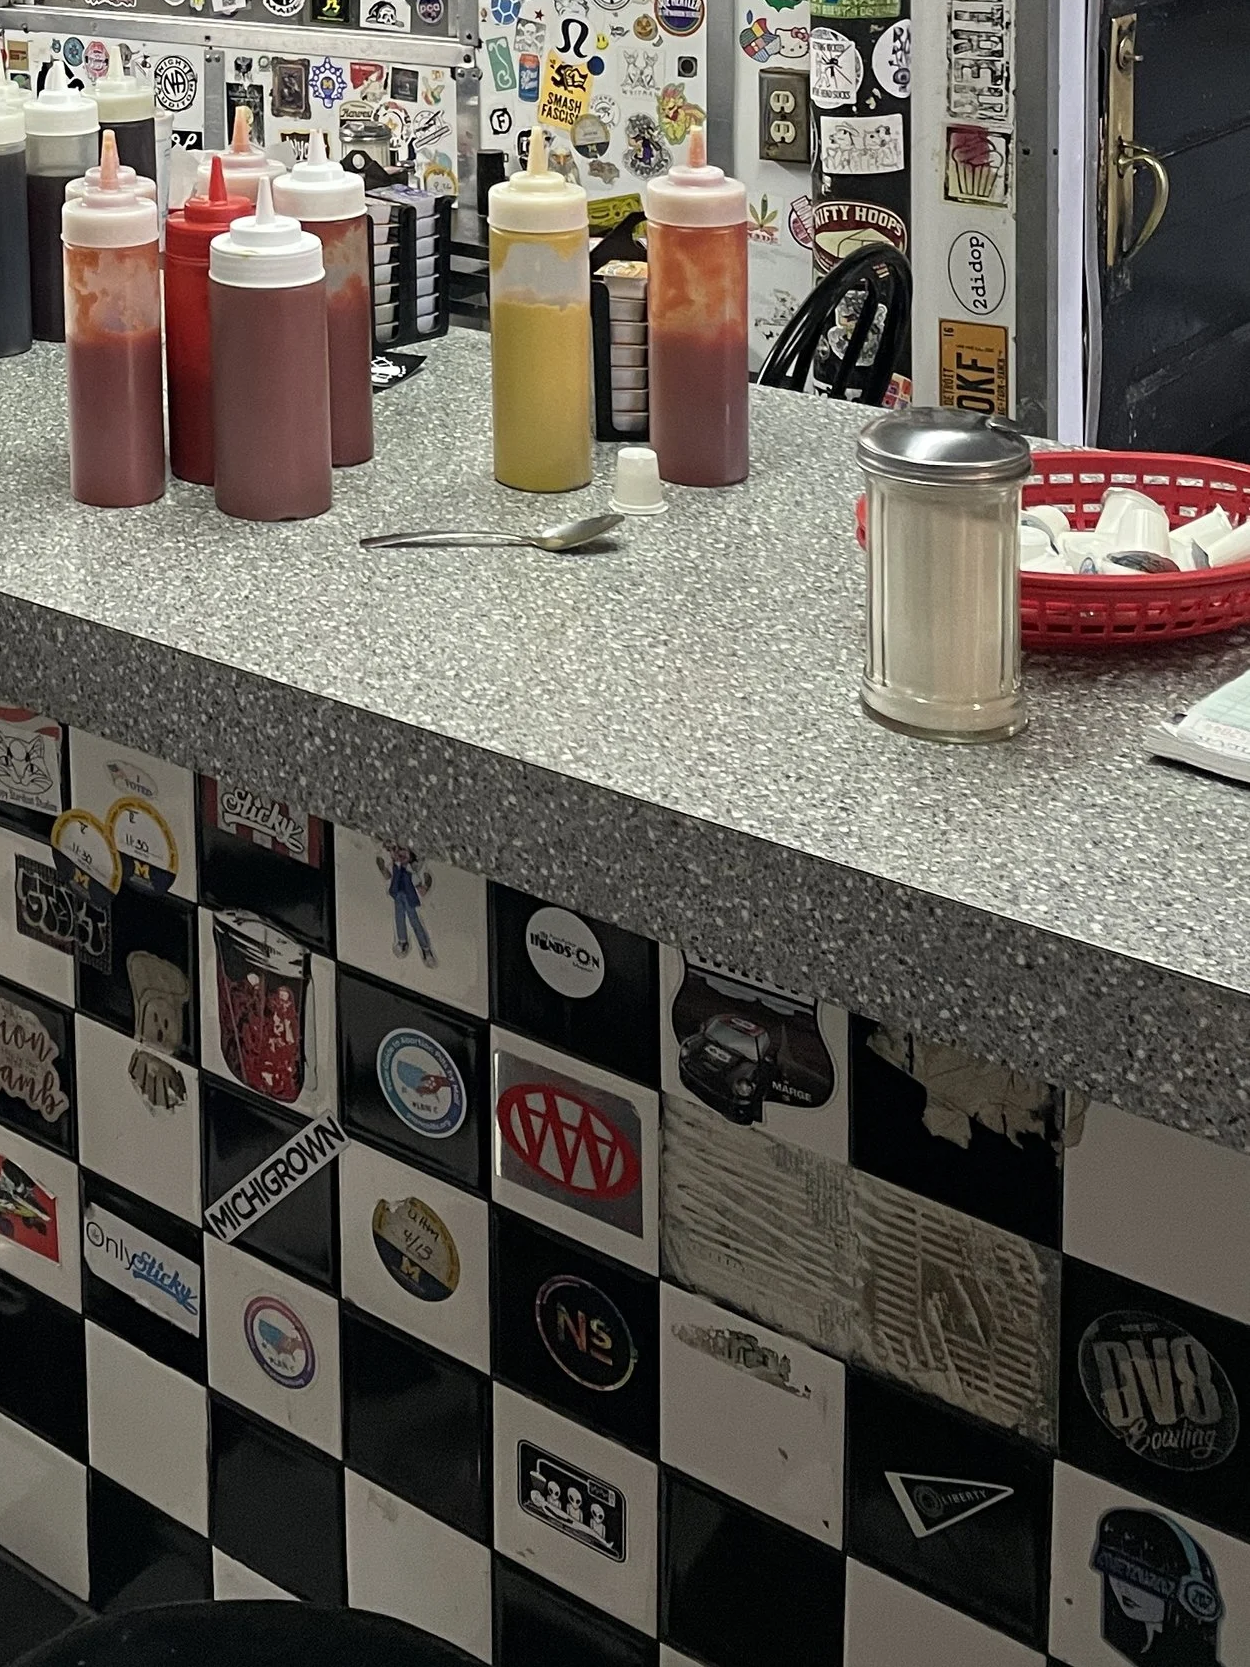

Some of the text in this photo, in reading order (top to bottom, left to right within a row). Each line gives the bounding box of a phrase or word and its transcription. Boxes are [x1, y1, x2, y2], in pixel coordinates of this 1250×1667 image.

[266, 0, 299, 14] MADE
[156, 58, 189, 79] NIGHT
[547, 92, 582, 117] SMASH
[813, 205, 903, 236] NIFTY HOOPS
[968, 235, 988, 310] 2didop
[943, 326, 955, 408] DETROIT 16
[124, 776, 157, 799] VOTED
[222, 786, 306, 855] Sticky
[71, 839, 95, 867] 11:30
[123, 832, 150, 854] 11:30
[73, 866, 91, 891] M
[134, 859, 151, 879] M
[771, 1080, 812, 1102] MARGE
[208, 1113, 348, 1241] MICHIGROWN
[1093, 1335, 1223, 1427] DV8
[1126, 1420, 1219, 1458] Bowling
[941, 1488, 987, 1508] LIBERTY
